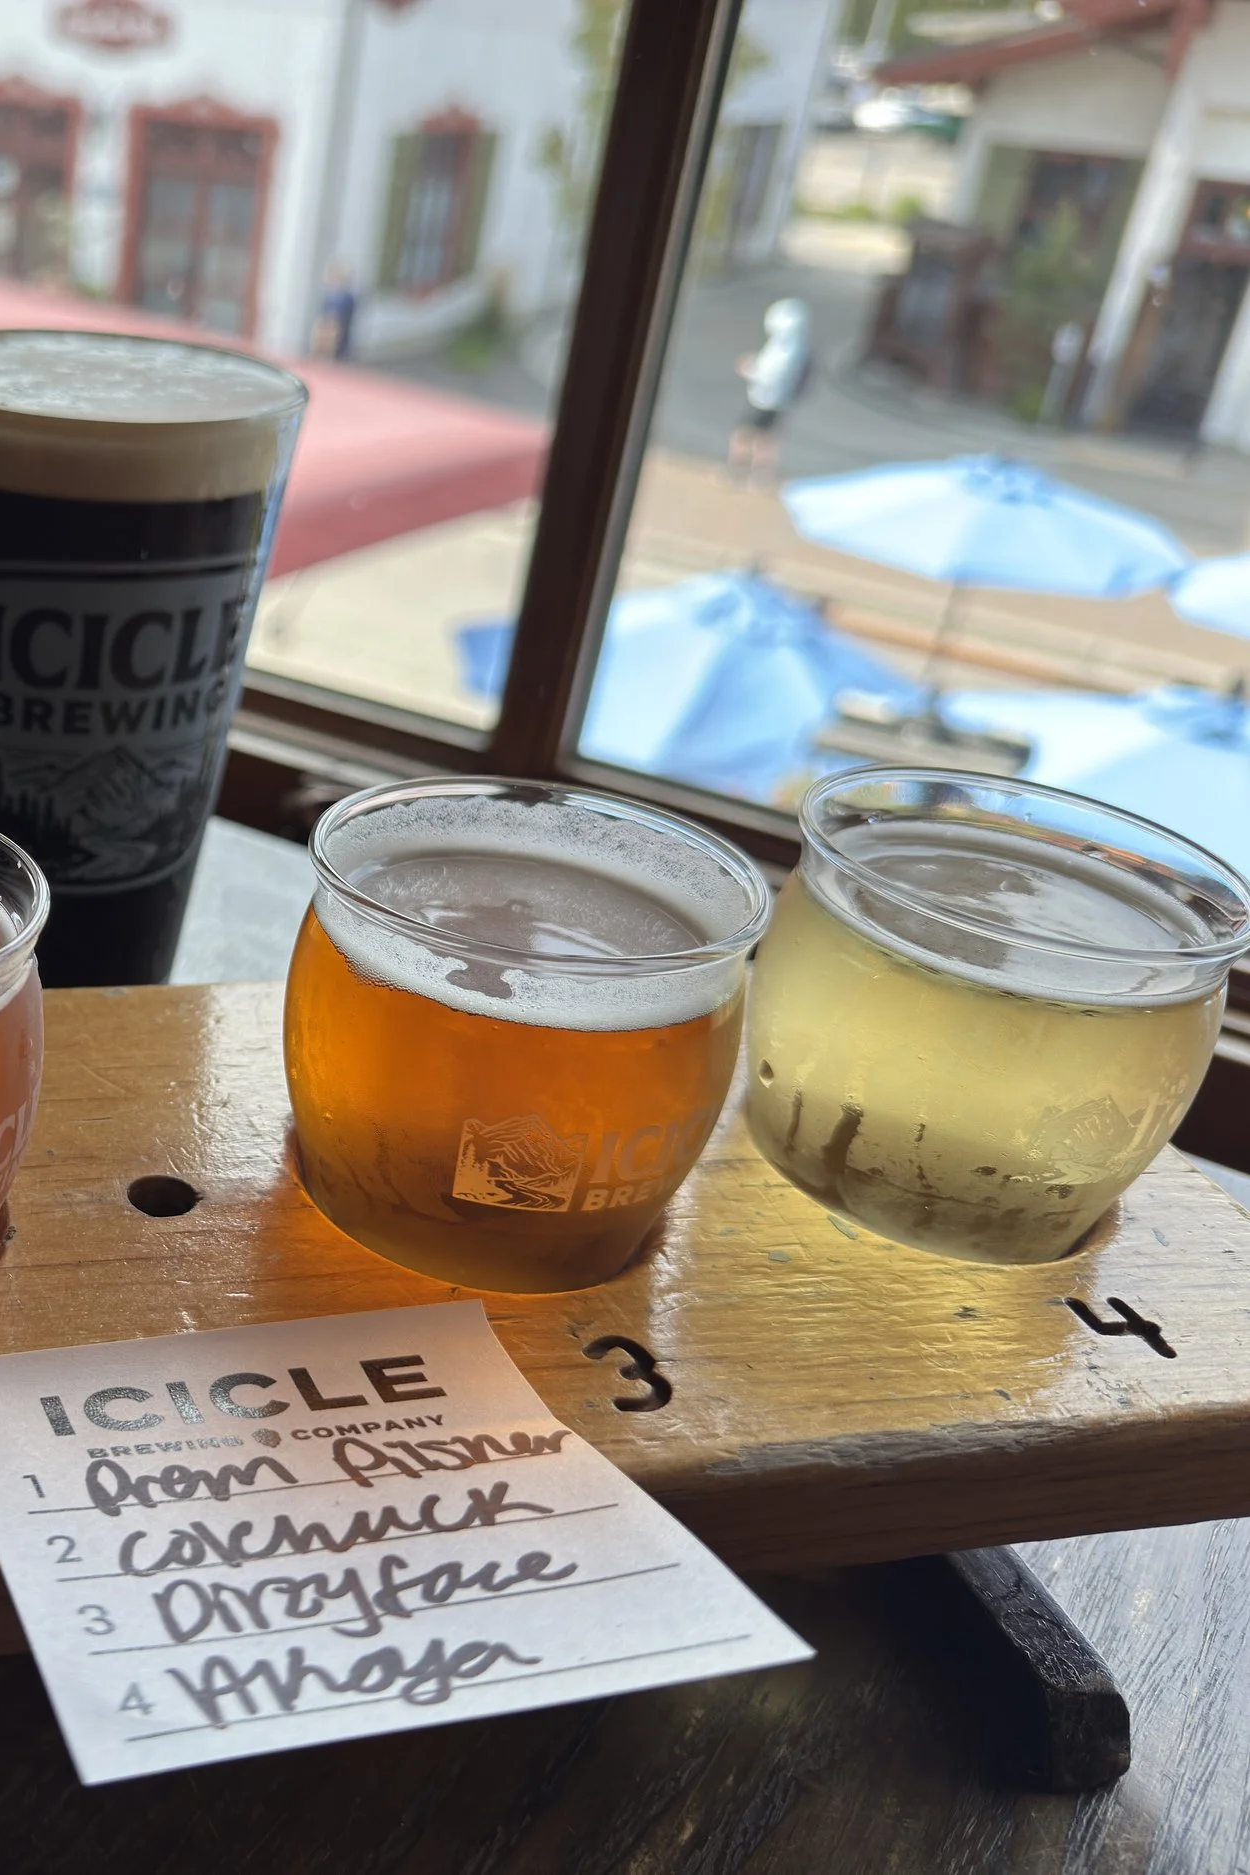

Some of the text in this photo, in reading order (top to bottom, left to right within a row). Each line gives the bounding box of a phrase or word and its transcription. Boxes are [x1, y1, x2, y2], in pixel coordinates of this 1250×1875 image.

[588, 1107, 710, 1184] ICIC
[1063, 1297, 1178, 1360] 4
[40, 1354, 448, 1437] ICICLE
[581, 1334, 673, 1413] 3
[86, 1414, 444, 1460] BREWING COMPANY
[22, 1474, 46, 1499] 1
[47, 1534, 84, 1564] 2
[77, 1603, 116, 1636] 3
[118, 1681, 155, 1716] 4
